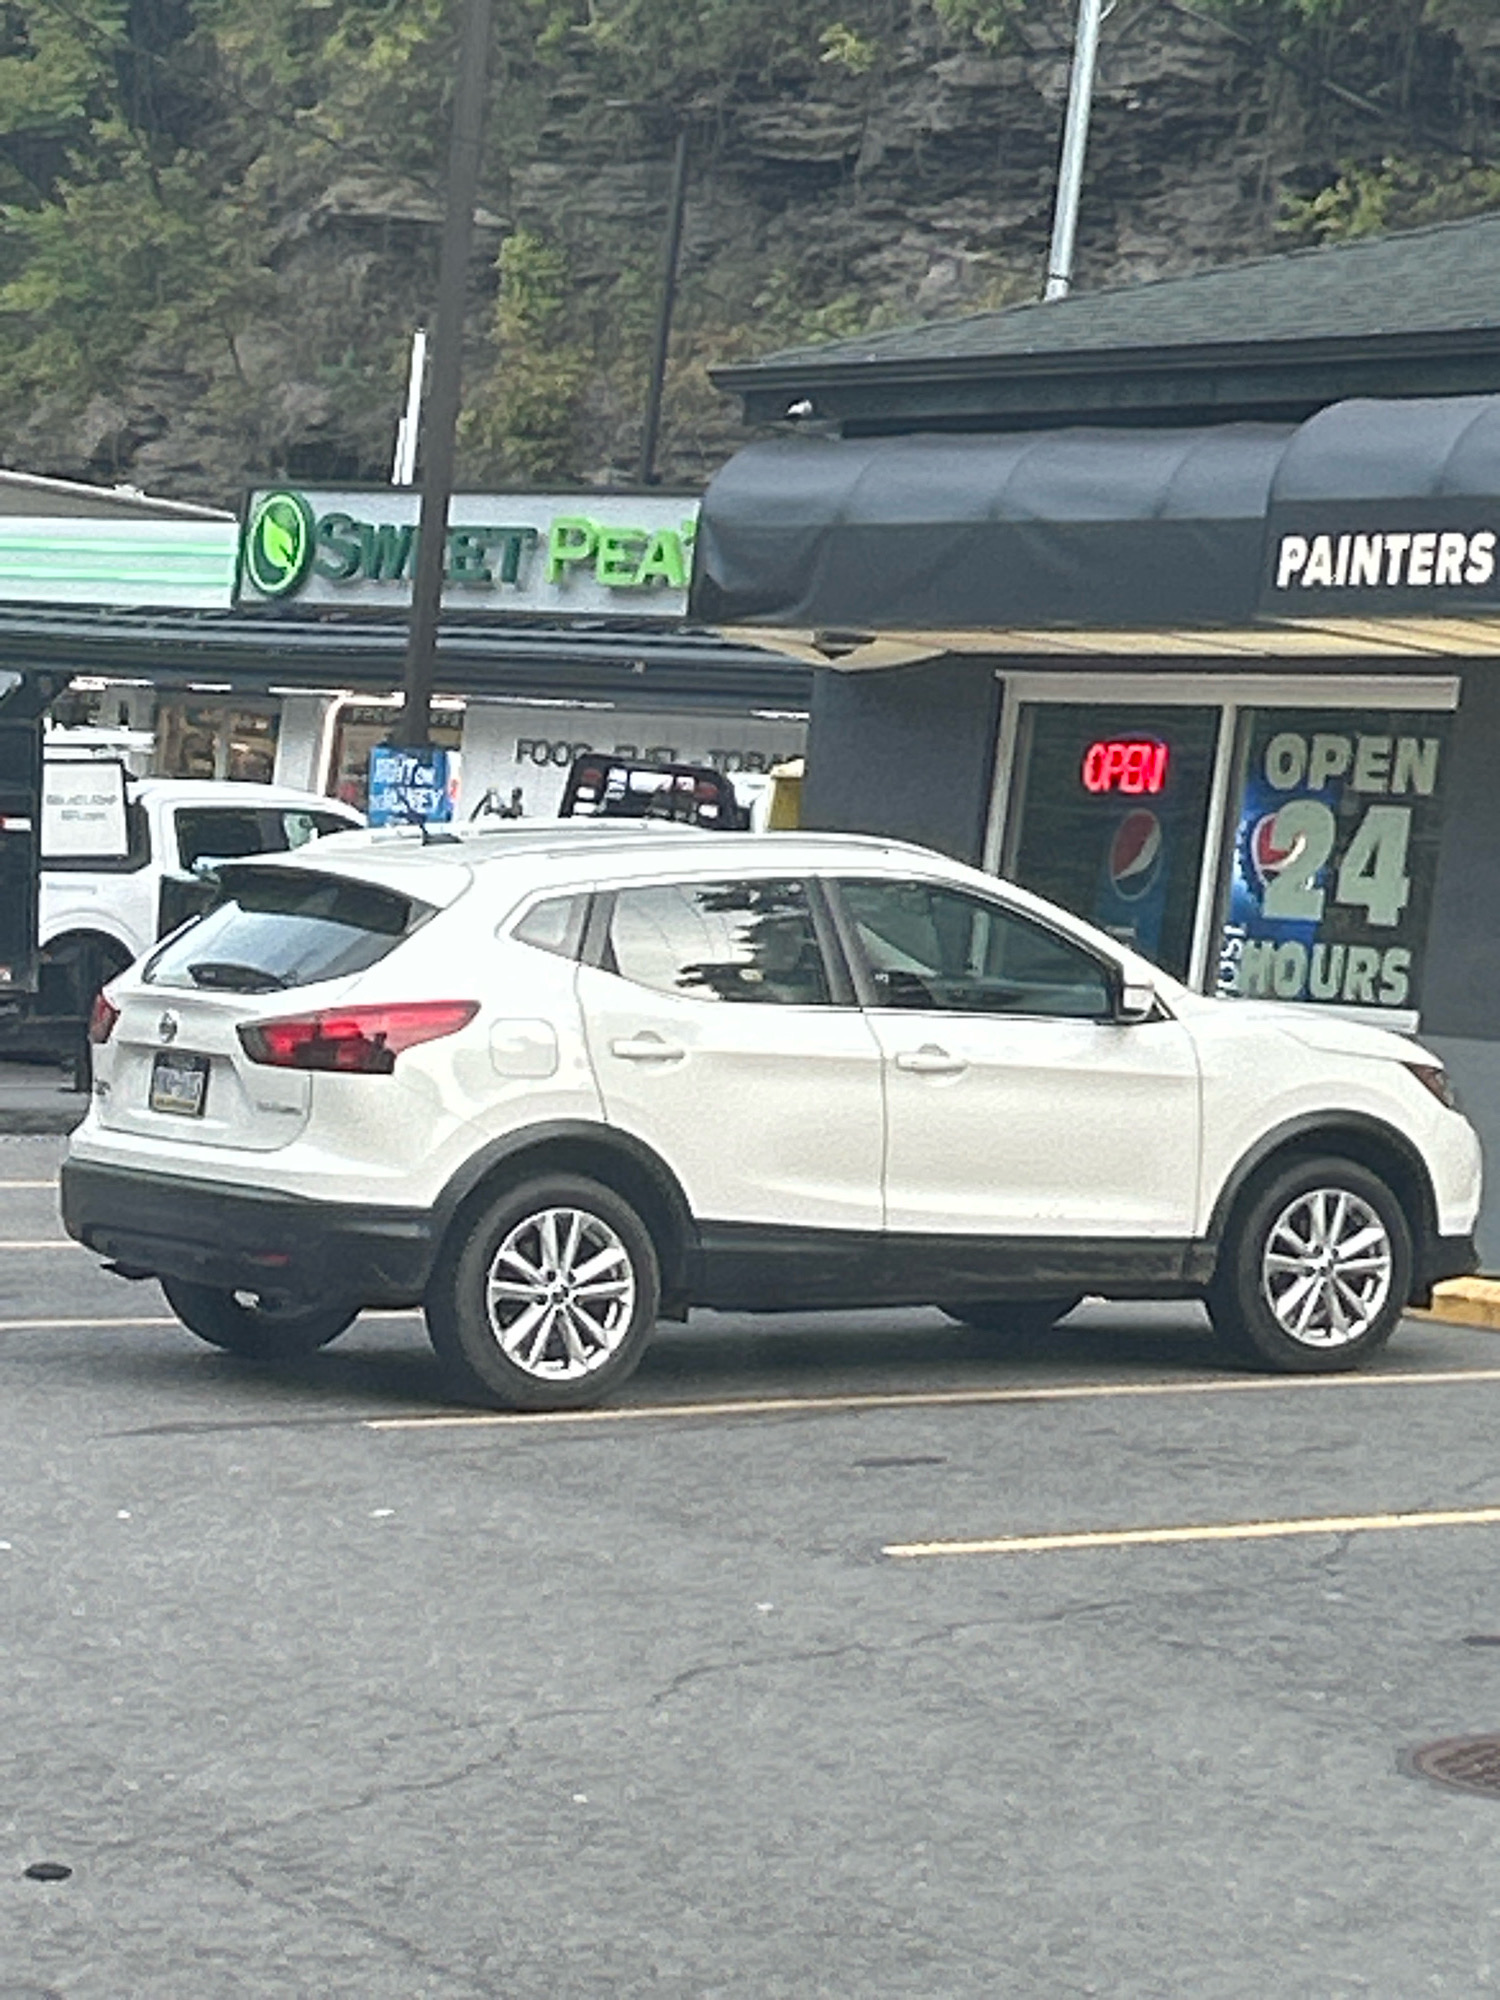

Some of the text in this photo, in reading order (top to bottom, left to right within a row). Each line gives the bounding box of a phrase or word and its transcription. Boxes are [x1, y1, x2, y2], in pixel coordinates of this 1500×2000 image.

[314, 512, 538, 584] SWET
[1276, 531, 1497, 587] PAINTERS
[1082, 742, 1168, 793] OPEN
[1265, 733, 1440, 796] OPEN
[1262, 800, 1412, 926] 24
[1240, 940, 1412, 1005] HOURS
